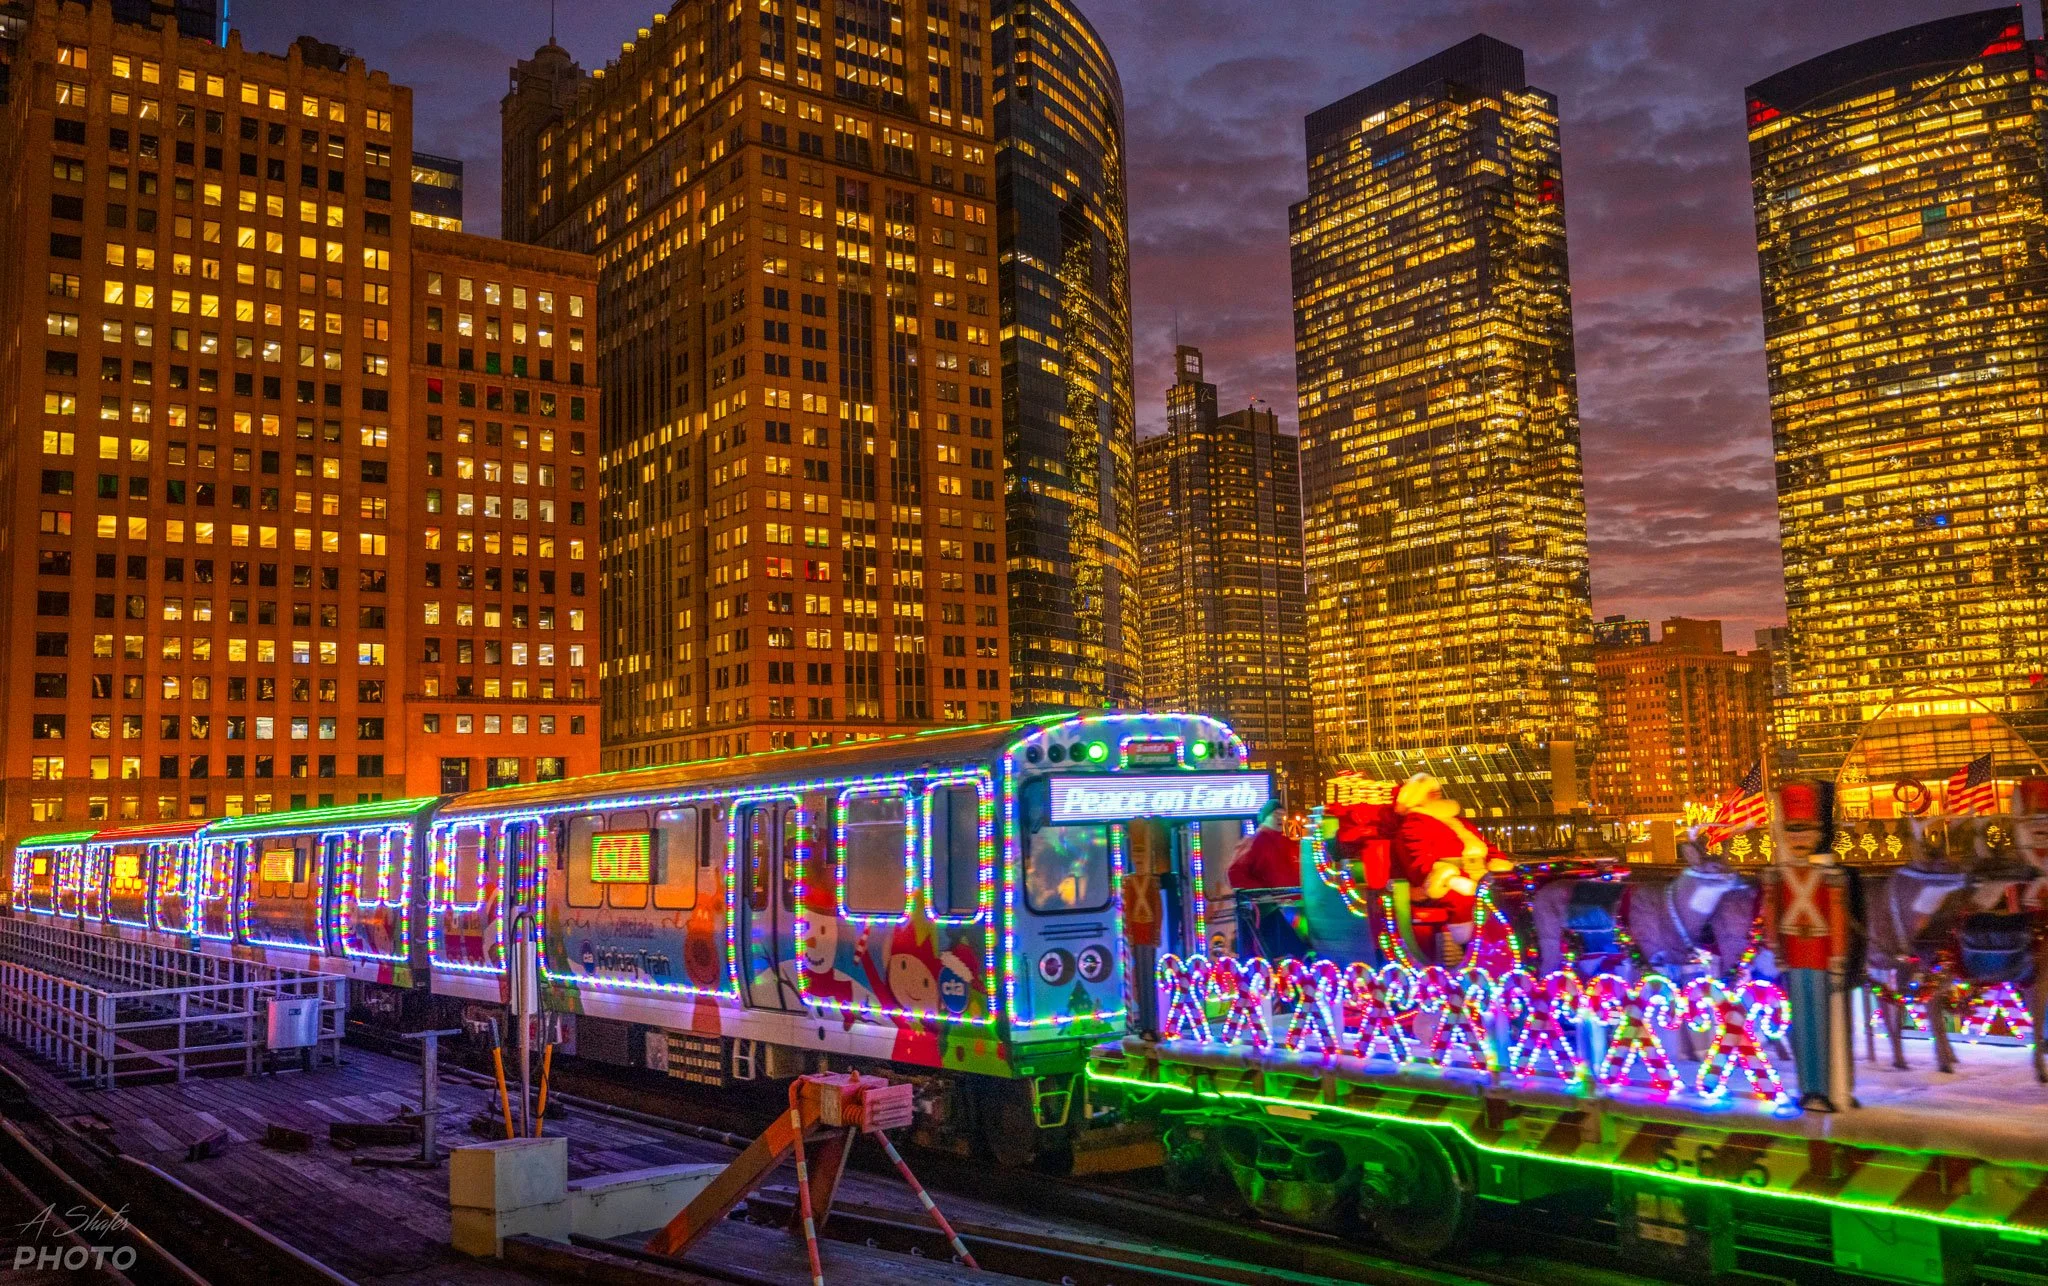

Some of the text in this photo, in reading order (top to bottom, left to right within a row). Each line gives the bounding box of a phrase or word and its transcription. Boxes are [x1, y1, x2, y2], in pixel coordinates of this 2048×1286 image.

[1063, 781, 1258, 814] Peace on Earth
[597, 837, 643, 878] CTA
[596, 944, 672, 979] Holiday Train
[941, 979, 965, 996] cta
